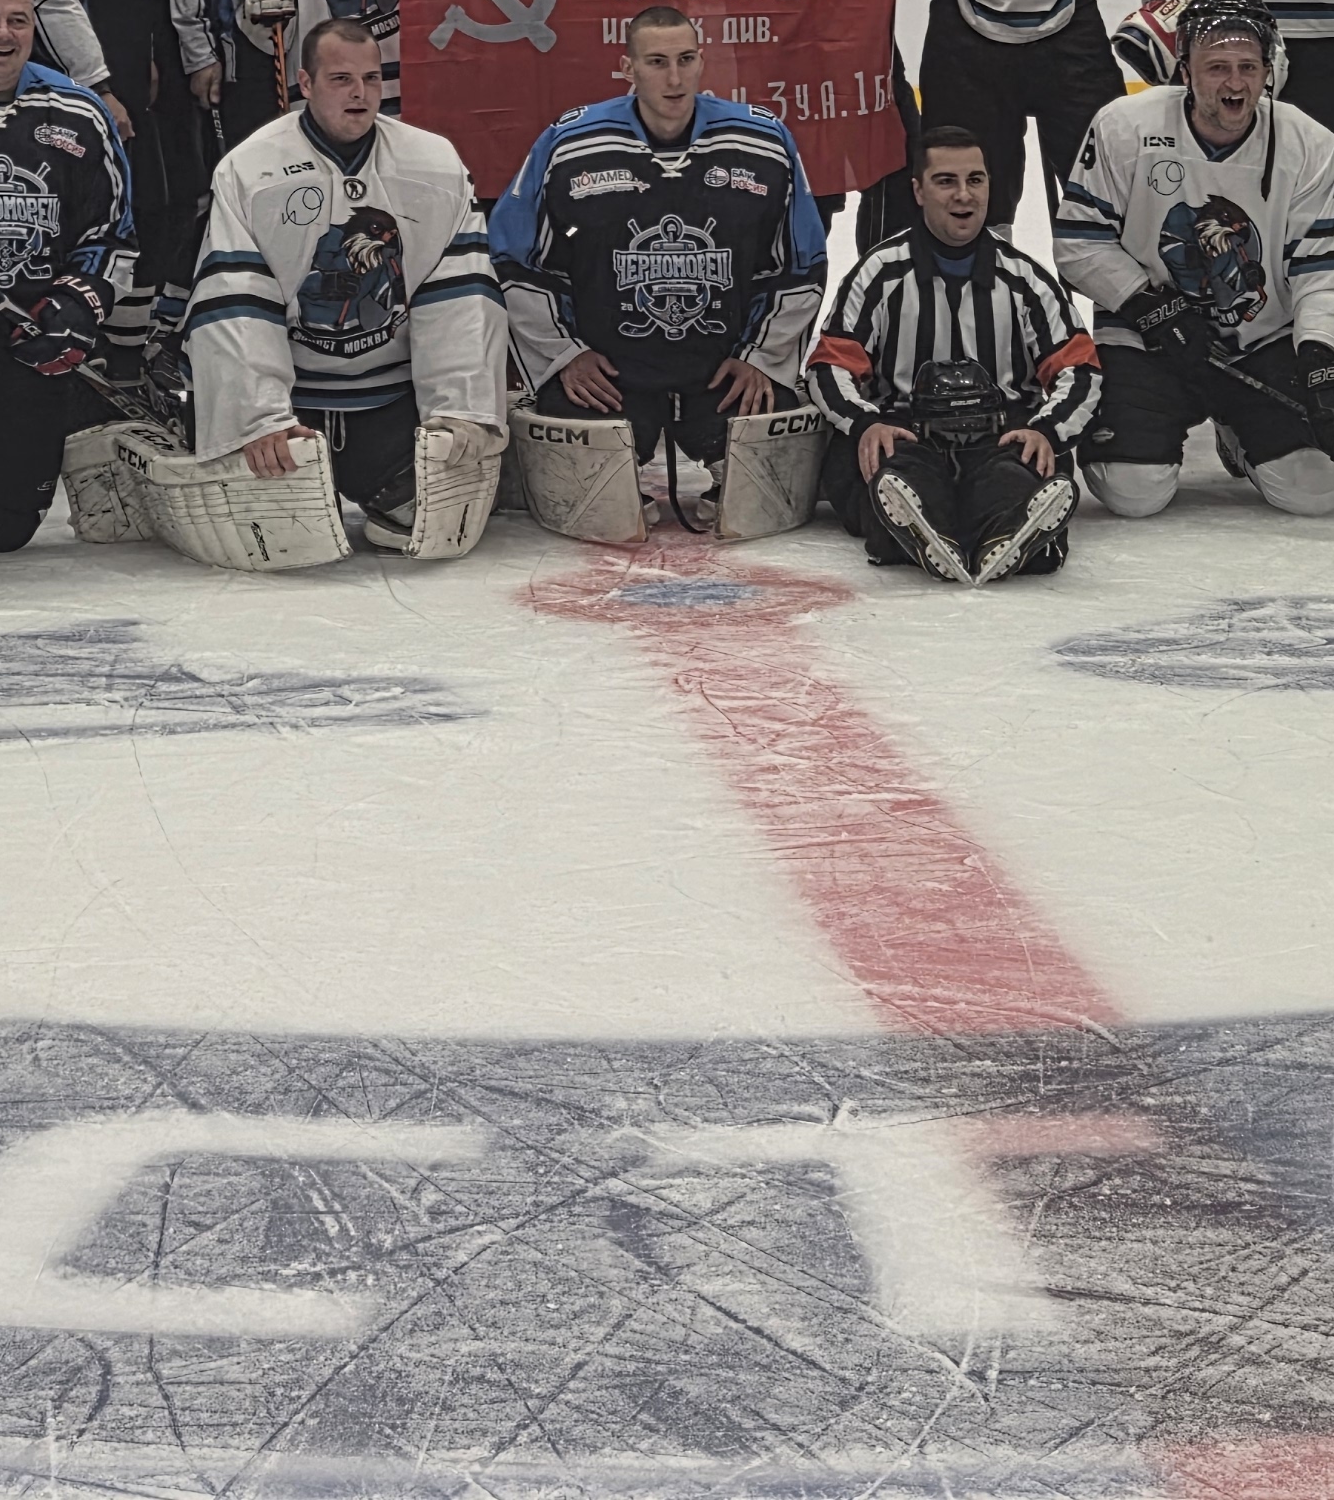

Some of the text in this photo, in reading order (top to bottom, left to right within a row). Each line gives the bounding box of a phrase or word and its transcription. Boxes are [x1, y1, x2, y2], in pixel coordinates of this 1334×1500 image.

[570, 169, 633, 191] NOVAMED
[616, 252, 731, 288] ЧЕРНОМОРЕЦ
[343, 331, 389, 354] МОСКВА
[528, 423, 590, 446] CCM
[767, 412, 821, 437] CCM
[118, 444, 148, 475] CCM
